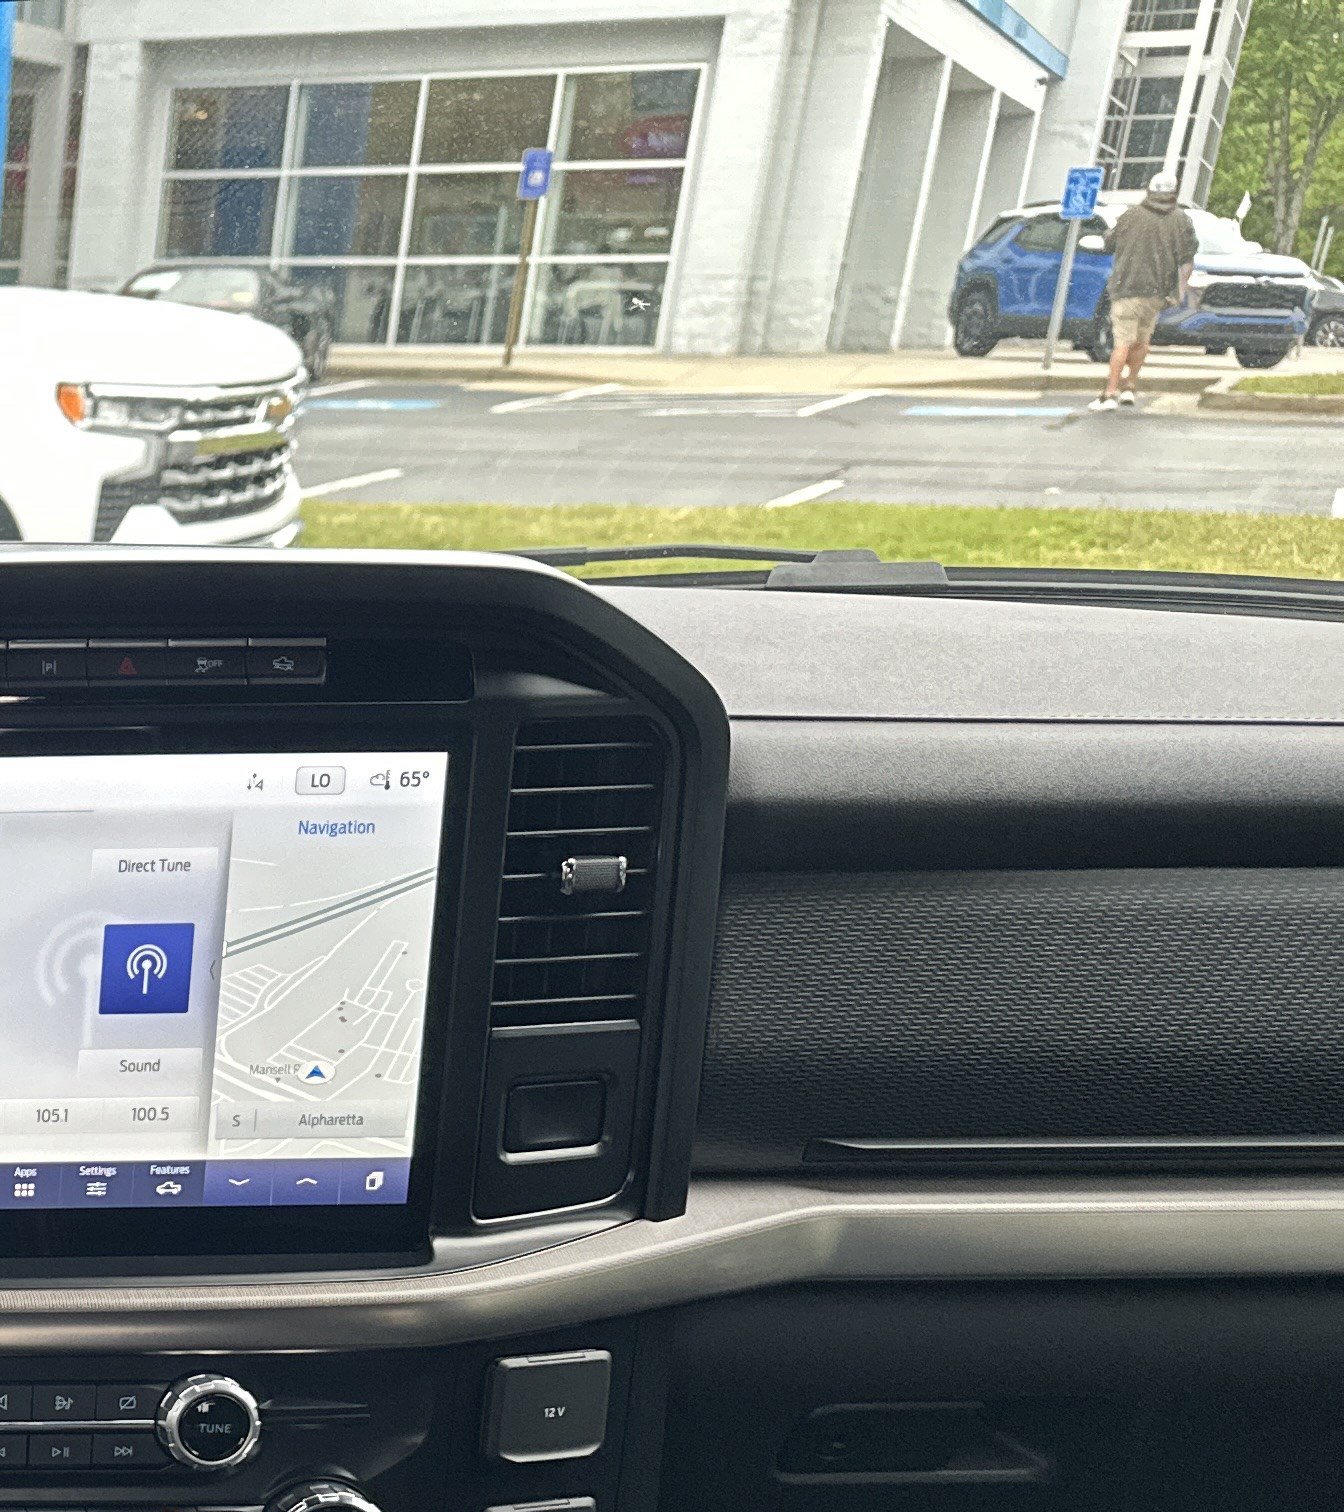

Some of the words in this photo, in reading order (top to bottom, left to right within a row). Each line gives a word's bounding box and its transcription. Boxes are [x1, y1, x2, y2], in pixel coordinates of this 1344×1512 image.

[310, 773, 331, 788] LO
[399, 770, 431, 788] 65°
[297, 820, 376, 838] Navigation
[118, 859, 156, 874] Direct
[159, 858, 191, 873] Tune
[119, 1058, 161, 1074] Sound
[249, 1064, 292, 1076] Mansell
[36, 1108, 69, 1123] 105.1
[131, 1107, 170, 1122] 100.5
[232, 1114, 241, 1128] S
[298, 1113, 365, 1128] Alpharetta
[14, 1166, 38, 1179] Apps
[79, 1165, 117, 1178] Settings
[150, 1164, 190, 1175] Features
[544, 1407, 555, 1418] 12
[557, 1406, 566, 1417] V
[198, 1424, 232, 1434] TUNE
